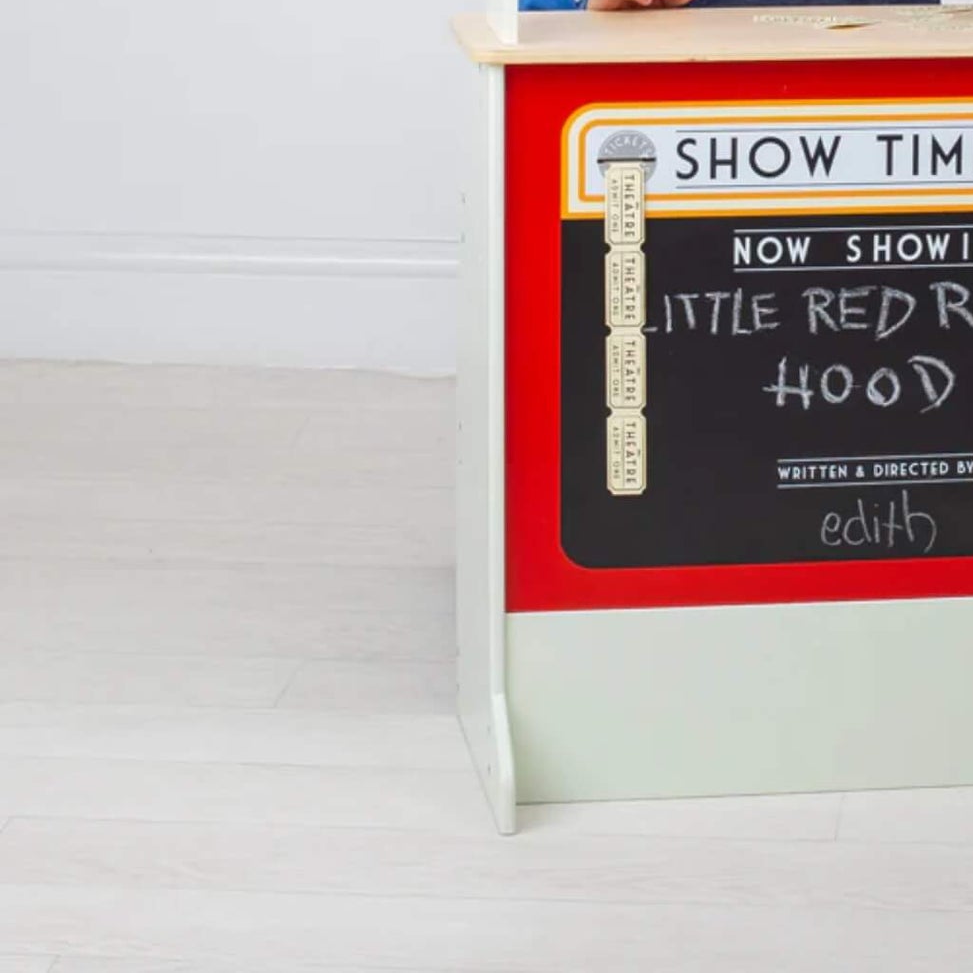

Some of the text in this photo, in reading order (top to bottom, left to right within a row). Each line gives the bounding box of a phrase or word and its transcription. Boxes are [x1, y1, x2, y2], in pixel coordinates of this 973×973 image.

[676, 135, 842, 180] SHOW
[611, 179, 620, 209] ADMIT
[624, 174, 636, 237] THEATRE
[733, 236, 811, 265] NOW
[624, 258, 636, 320] THEATRE
[643, 287, 782, 335] ITTLE
[802, 285, 917, 341] RED
[624, 340, 636, 402] THEATRE
[762, 355, 956, 413] HOOD
[625, 422, 637, 484] THEATRE
[777, 464, 849, 480] WRITTEN
[854, 464, 866, 478] &
[873, 460, 950, 477] DIRECTED
[820, 488, 938, 554] edith
